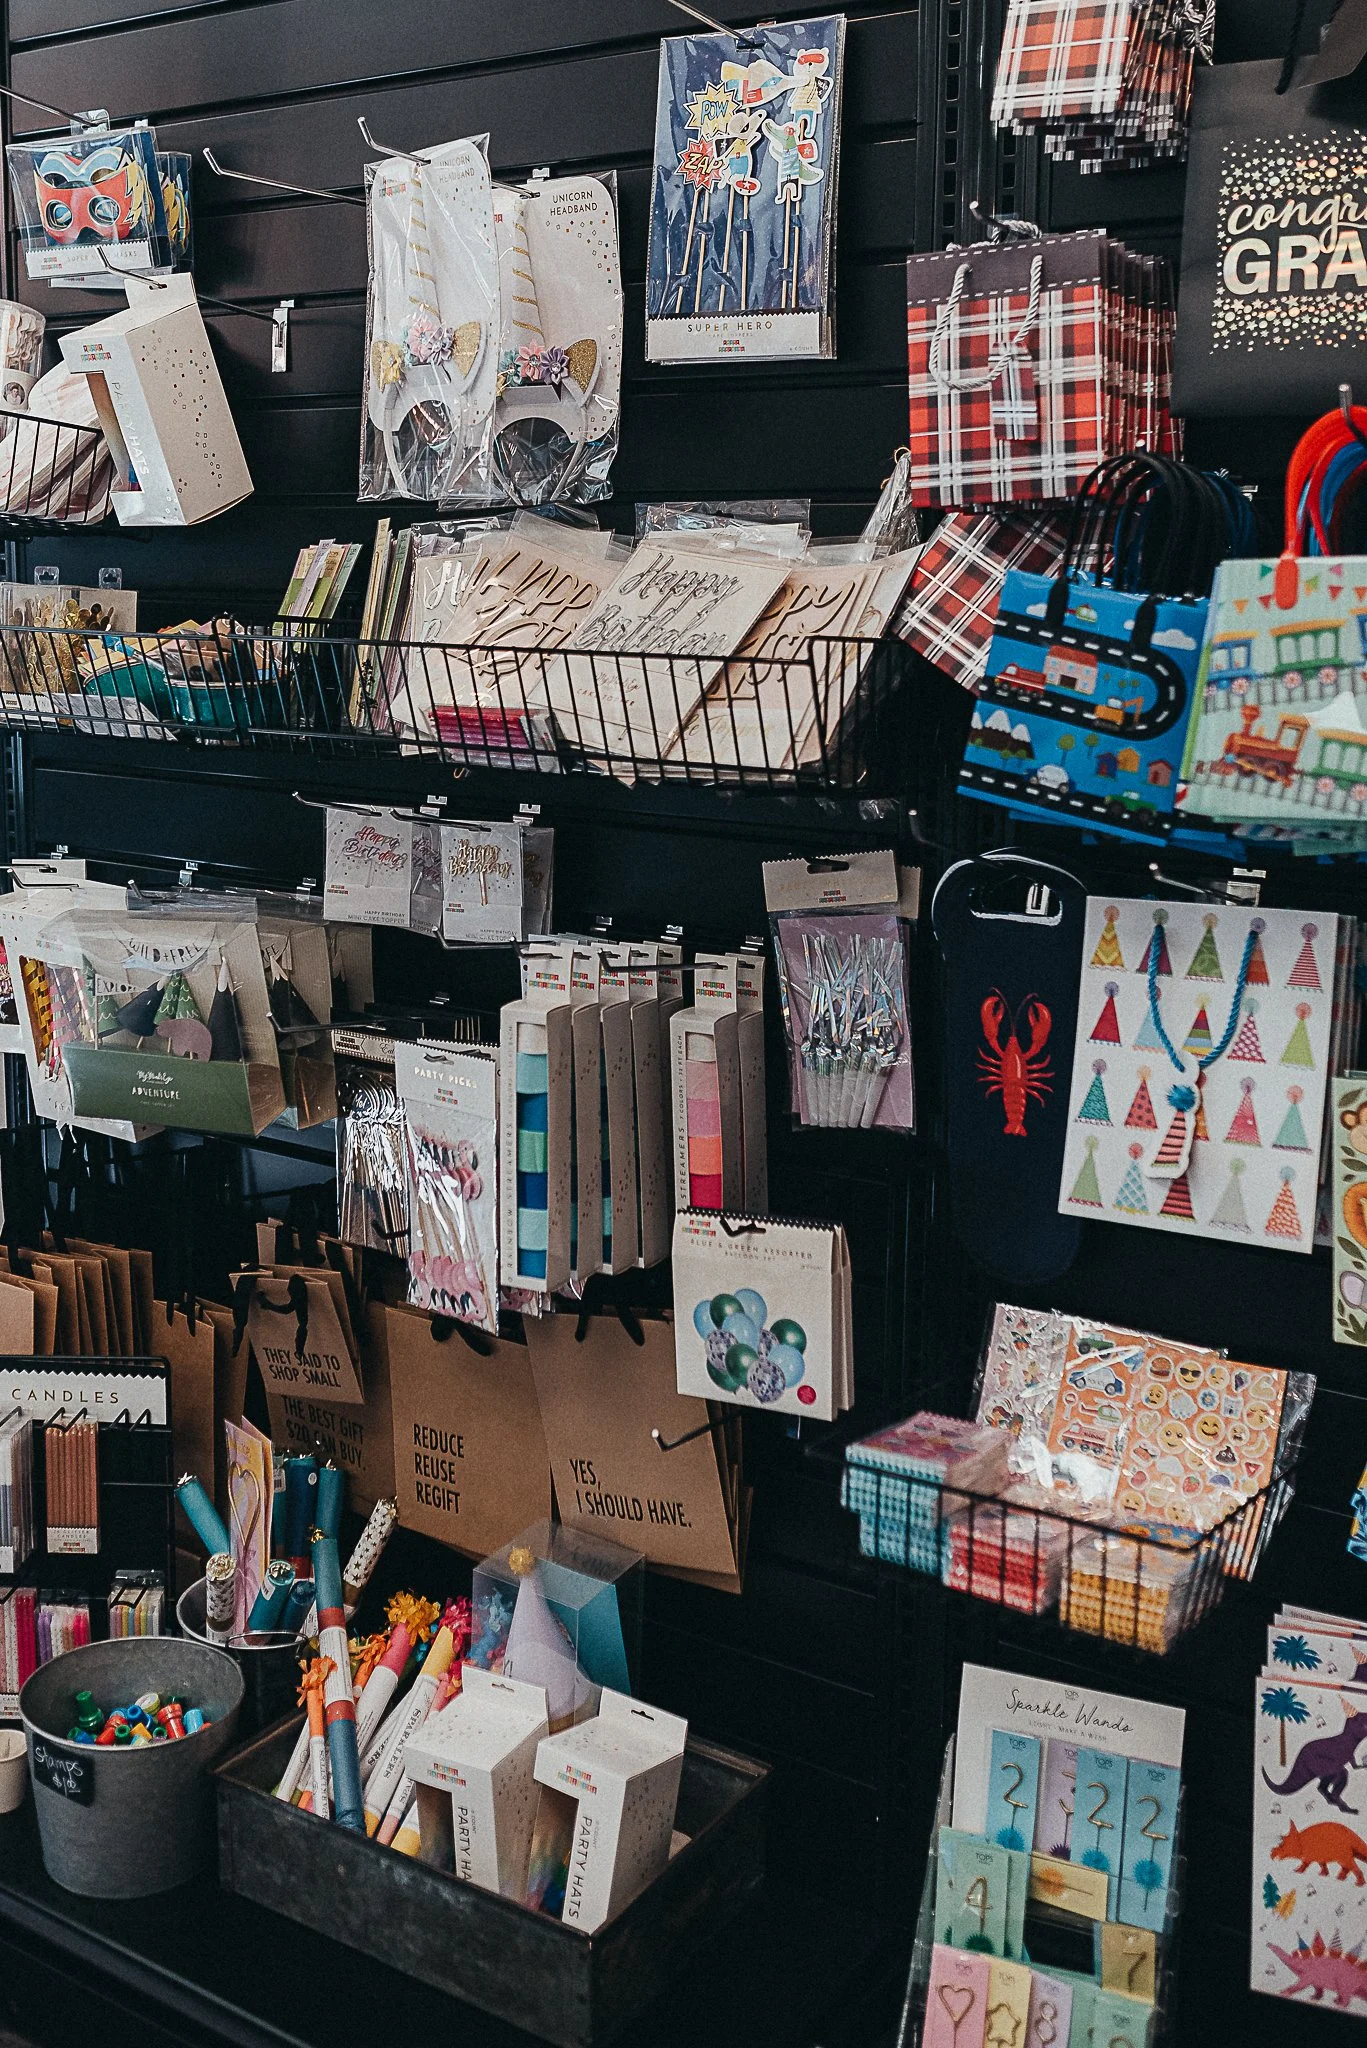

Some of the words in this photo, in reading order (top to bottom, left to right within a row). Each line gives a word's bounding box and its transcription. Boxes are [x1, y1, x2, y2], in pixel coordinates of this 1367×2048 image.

[701, 100, 729, 124] POW
[439, 155, 470, 167] UNICORN
[685, 153, 722, 174] ZAP
[550, 202, 598, 216] HEADBAND
[552, 190, 594, 204] UNICORN
[1228, 193, 1367, 254] congr
[688, 322, 729, 332] SUPER
[737, 321, 773, 330] HERO
[128, 435, 149, 475] HATS
[355, 826, 400, 849] Happy
[344, 838, 408, 869] Birthday
[97, 978, 136, 994] EXPLOR
[132, 1086, 180, 1100] ADVENTURE
[414, 1066, 444, 1081] PARTY
[448, 1075, 478, 1089] PICKS
[678, 1127, 687, 1200] STREAMERS
[690, 1240, 712, 1248] BLUE
[728, 1244, 758, 1252] GREEN
[262, 1348, 292, 1364] THEY
[295, 1352, 322, 1368] SAID
[325, 1355, 340, 1371] TO
[268, 1365, 300, 1382] SHOP
[302, 1370, 342, 1388] SMALL
[12, 1388, 119, 1404] CANDLES
[281, 1395, 306, 1416] THE
[308, 1404, 336, 1431] BEST
[340, 1418, 364, 1445] GIFT
[286, 1419, 310, 1442] $20
[314, 1431, 336, 1455] CAN
[339, 1441, 366, 1471] BUY.
[413, 1423, 464, 1458] REDUCE
[414, 1452, 456, 1484] REUSE
[569, 1458, 602, 1490] YES,
[416, 1480, 460, 1514] REGIFT
[575, 1490, 583, 1514] I
[584, 1491, 644, 1522] SHOULD
[650, 1499, 692, 1528] HAVE.
[1006, 1688, 1068, 1714] Sparkle
[1076, 1704, 1134, 1732] Wands
[384, 1708, 422, 1780] SPARKLERS
[1009, 1738, 1026, 1748] TOPS
[1064, 1748, 1078, 1758] TOP
[34, 1746, 83, 1778] Stamps
[1094, 1756, 1113, 1768] TOPS
[1147, 1769, 1166, 1780] TOPS
[1001, 1762, 1028, 1809] 2
[1087, 1782, 1114, 1829] 2
[1136, 1796, 1169, 1840] 2
[458, 1806, 471, 1857] PARTY
[576, 1816, 592, 1872] PARTY
[460, 1860, 473, 1881] HA
[976, 1852, 994, 1864] TOPS
[568, 1874, 586, 1920] HATS
[1036, 2000, 1057, 2044] 8
